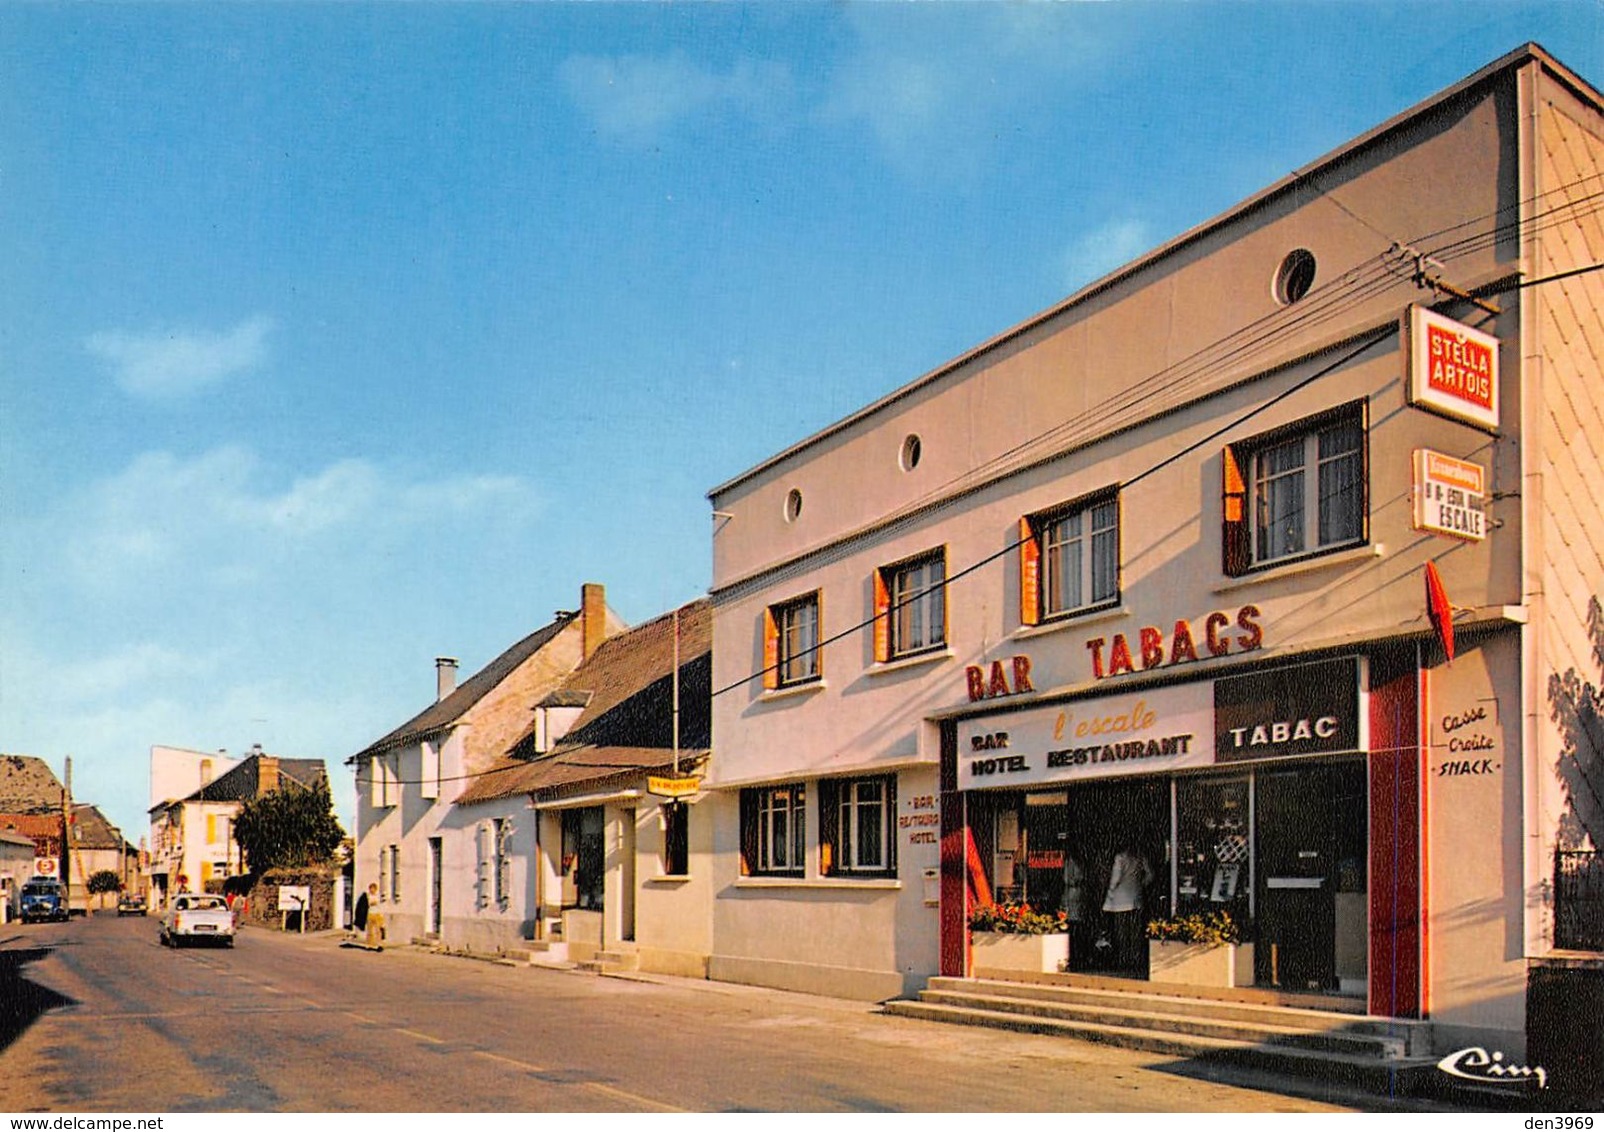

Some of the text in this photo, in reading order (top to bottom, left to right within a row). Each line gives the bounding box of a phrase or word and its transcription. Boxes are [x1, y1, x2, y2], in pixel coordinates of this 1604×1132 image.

[1432, 335, 1489, 375] STELLA
[1433, 360, 1489, 399] ARTOIS
[1440, 504, 1480, 535] ESCALE
[966, 604, 1264, 701] BAR TABACS
[1053, 701, 1158, 741] l'escale
[1229, 716, 1339, 748] TABAC
[1442, 706, 1487, 733] Casse
[971, 732, 1010, 751] BAR
[971, 734, 1193, 776] HOTEL RESTAURANT
[1439, 759, 1493, 776] SNACK
[913, 795, 935, 809] BAR
[910, 832, 937, 844] HOTEL
